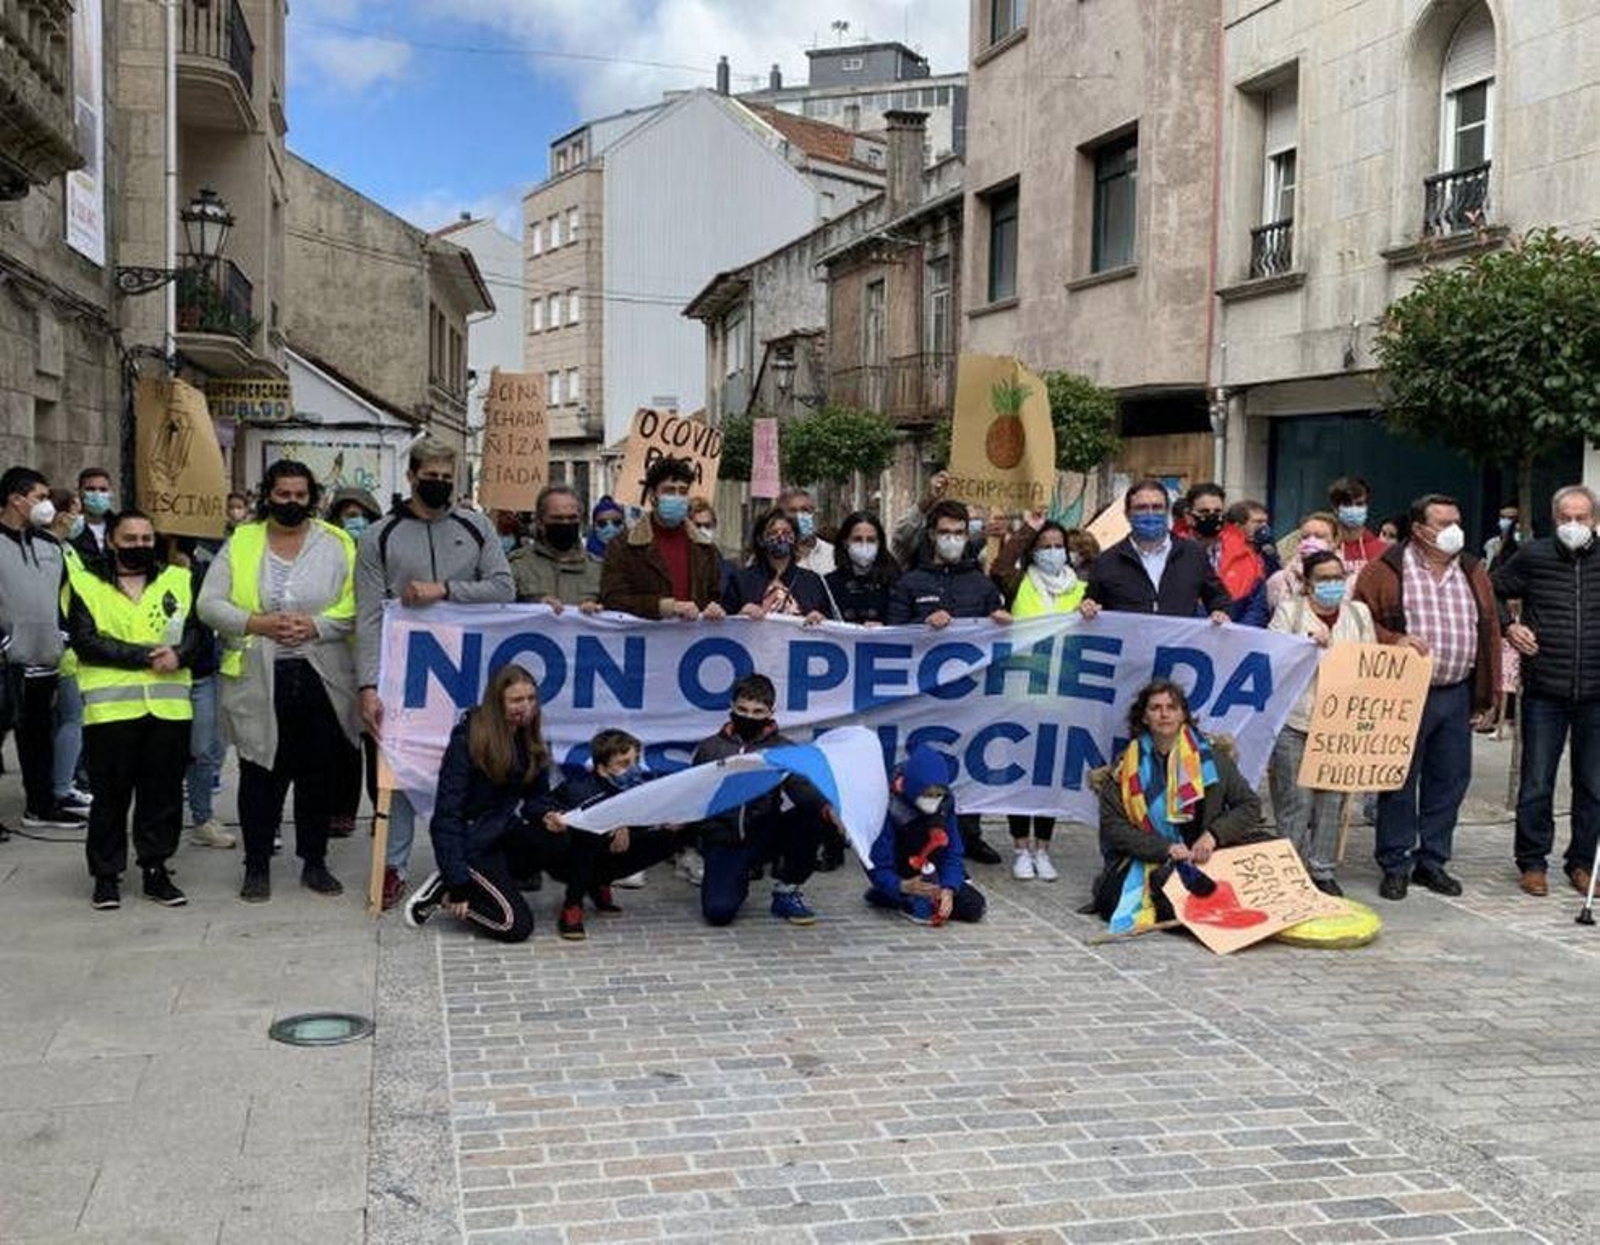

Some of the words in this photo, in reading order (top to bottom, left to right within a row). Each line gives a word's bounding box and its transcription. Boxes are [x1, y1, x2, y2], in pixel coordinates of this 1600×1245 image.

[639, 410, 659, 438] O
[660, 417, 721, 459] COVID
[404, 630, 645, 709] NON
[678, 637, 755, 711] O
[786, 635, 1123, 712] PECHE
[1152, 646, 1273, 717] DA
[1358, 651, 1408, 680] NON
[1322, 693, 1338, 719] O
[1346, 696, 1413, 722] PECHE
[1311, 732, 1411, 755] SERVICIOS
